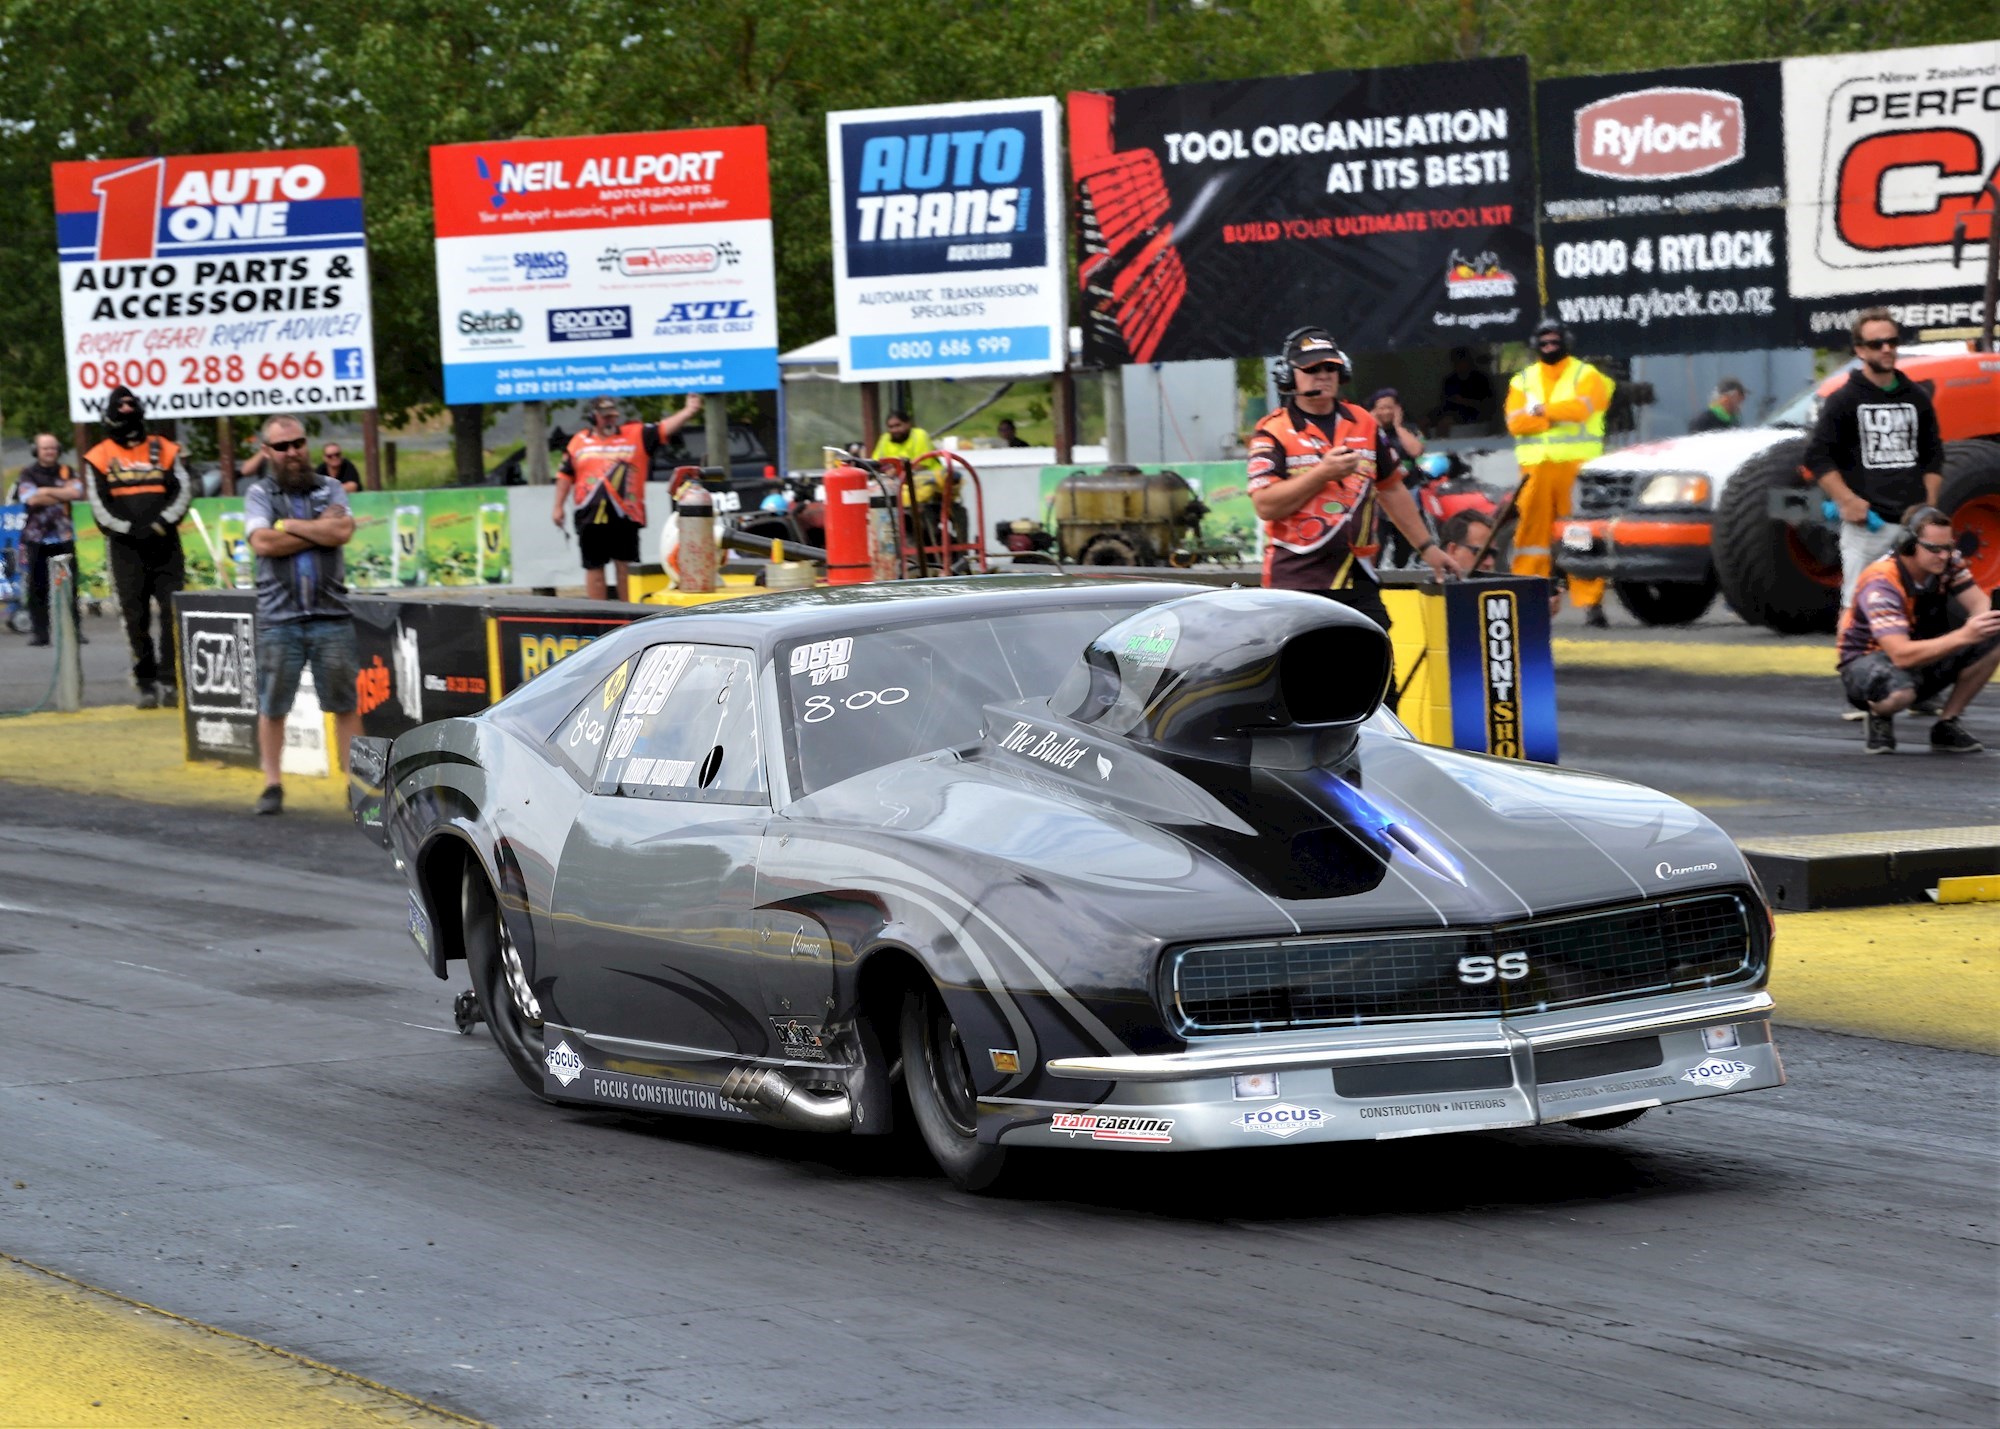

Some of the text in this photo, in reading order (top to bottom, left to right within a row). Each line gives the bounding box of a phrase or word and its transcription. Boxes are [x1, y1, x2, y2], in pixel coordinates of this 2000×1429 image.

[1878, 71, 1919, 83] New
[1164, 108, 1509, 165] TOOL ORGANISATION
[1592, 112, 1725, 167] Rylock
[500, 150, 723, 193] NEIL ALLPORT
[859, 127, 1025, 193] AUTO
[1326, 149, 1511, 194] AT ITS BEST!
[168, 164, 326, 206] AUTO
[598, 184, 712, 200] MOTORSPORTS
[168, 202, 290, 242] ONE
[857, 188, 1019, 242] TRANS
[1223, 205, 1514, 244] BUILD YOUR ULTIMATE TOOL KIT
[1554, 230, 1776, 279] 0800 4 RYLOCK
[74, 254, 354, 292] AUTO PARTS &
[92, 285, 342, 320] ACCESSORIES
[656, 300, 755, 323] ATL
[858, 282, 1039, 306] AUTOMATIC TRANSMISSION
[911, 301, 986, 319] SPECIALISTS
[1557, 285, 1777, 327] www.rylock.co.nz
[76, 313, 361, 359] RIGHT GEAR! RIGHT ADVICE!
[458, 308, 524, 335] Setrab
[551, 309, 627, 331] sparco
[887, 335, 1011, 360] 0800 686 999
[79, 351, 324, 389] 0800 288 666
[789, 637, 854, 676] 959
[998, 721, 1090, 770] The Bullet
[1655, 861, 1718, 881] Camaro
[1457, 951, 1530, 985] SS
[550, 1050, 579, 1069] FOCUS
[1687, 1061, 1746, 1079] FOCUS
[594, 1078, 629, 1100] FOCUS
[632, 1082, 716, 1110] CONSTRUCTION
[1539, 1086, 1599, 1104] REMEDIATION
[1604, 1075, 1677, 1094] REINSTATEMENTS
[1244, 1109, 1322, 1124] FOCUS
[1359, 1098, 1507, 1119] CONSTRUCTION INTERIORS
